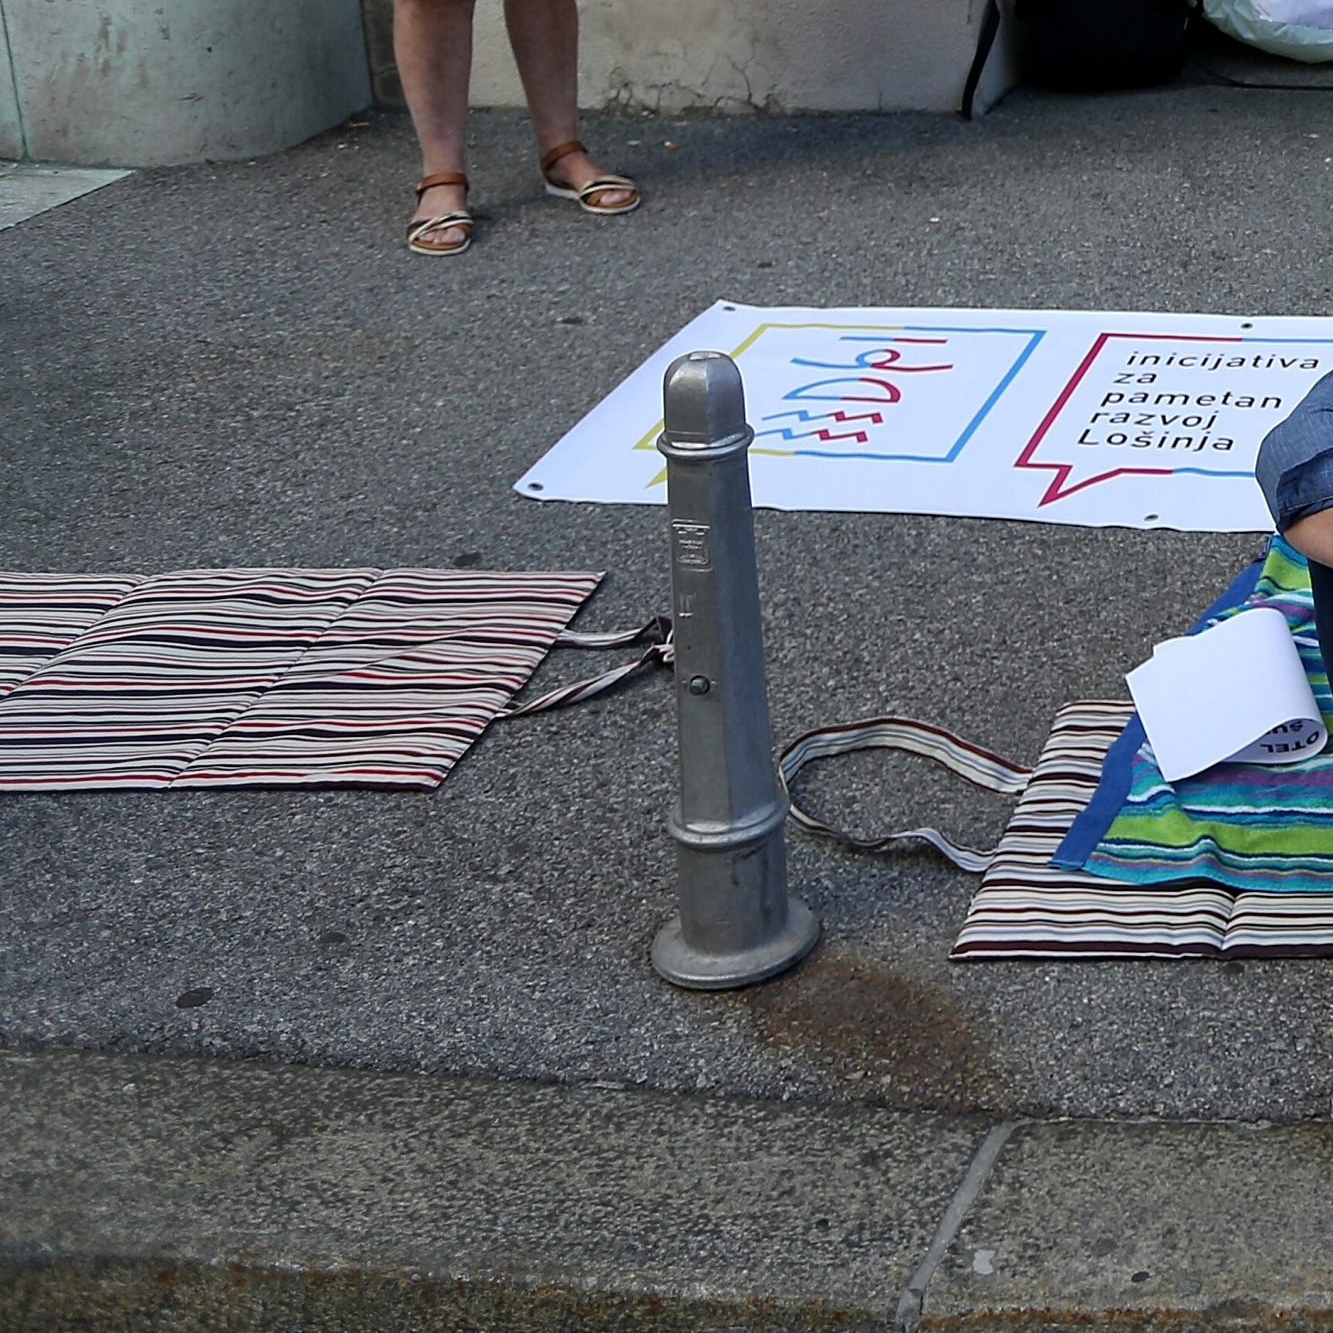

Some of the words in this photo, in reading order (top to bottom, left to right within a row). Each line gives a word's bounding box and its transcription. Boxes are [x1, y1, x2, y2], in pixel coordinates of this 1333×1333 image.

[1126, 351, 1320, 371] inicijativa
[1113, 372, 1158, 384] za
[1100, 391, 1283, 409] pametan
[1090, 410, 1220, 430] razvoj
[1077, 429, 1234, 452] Lošinja
